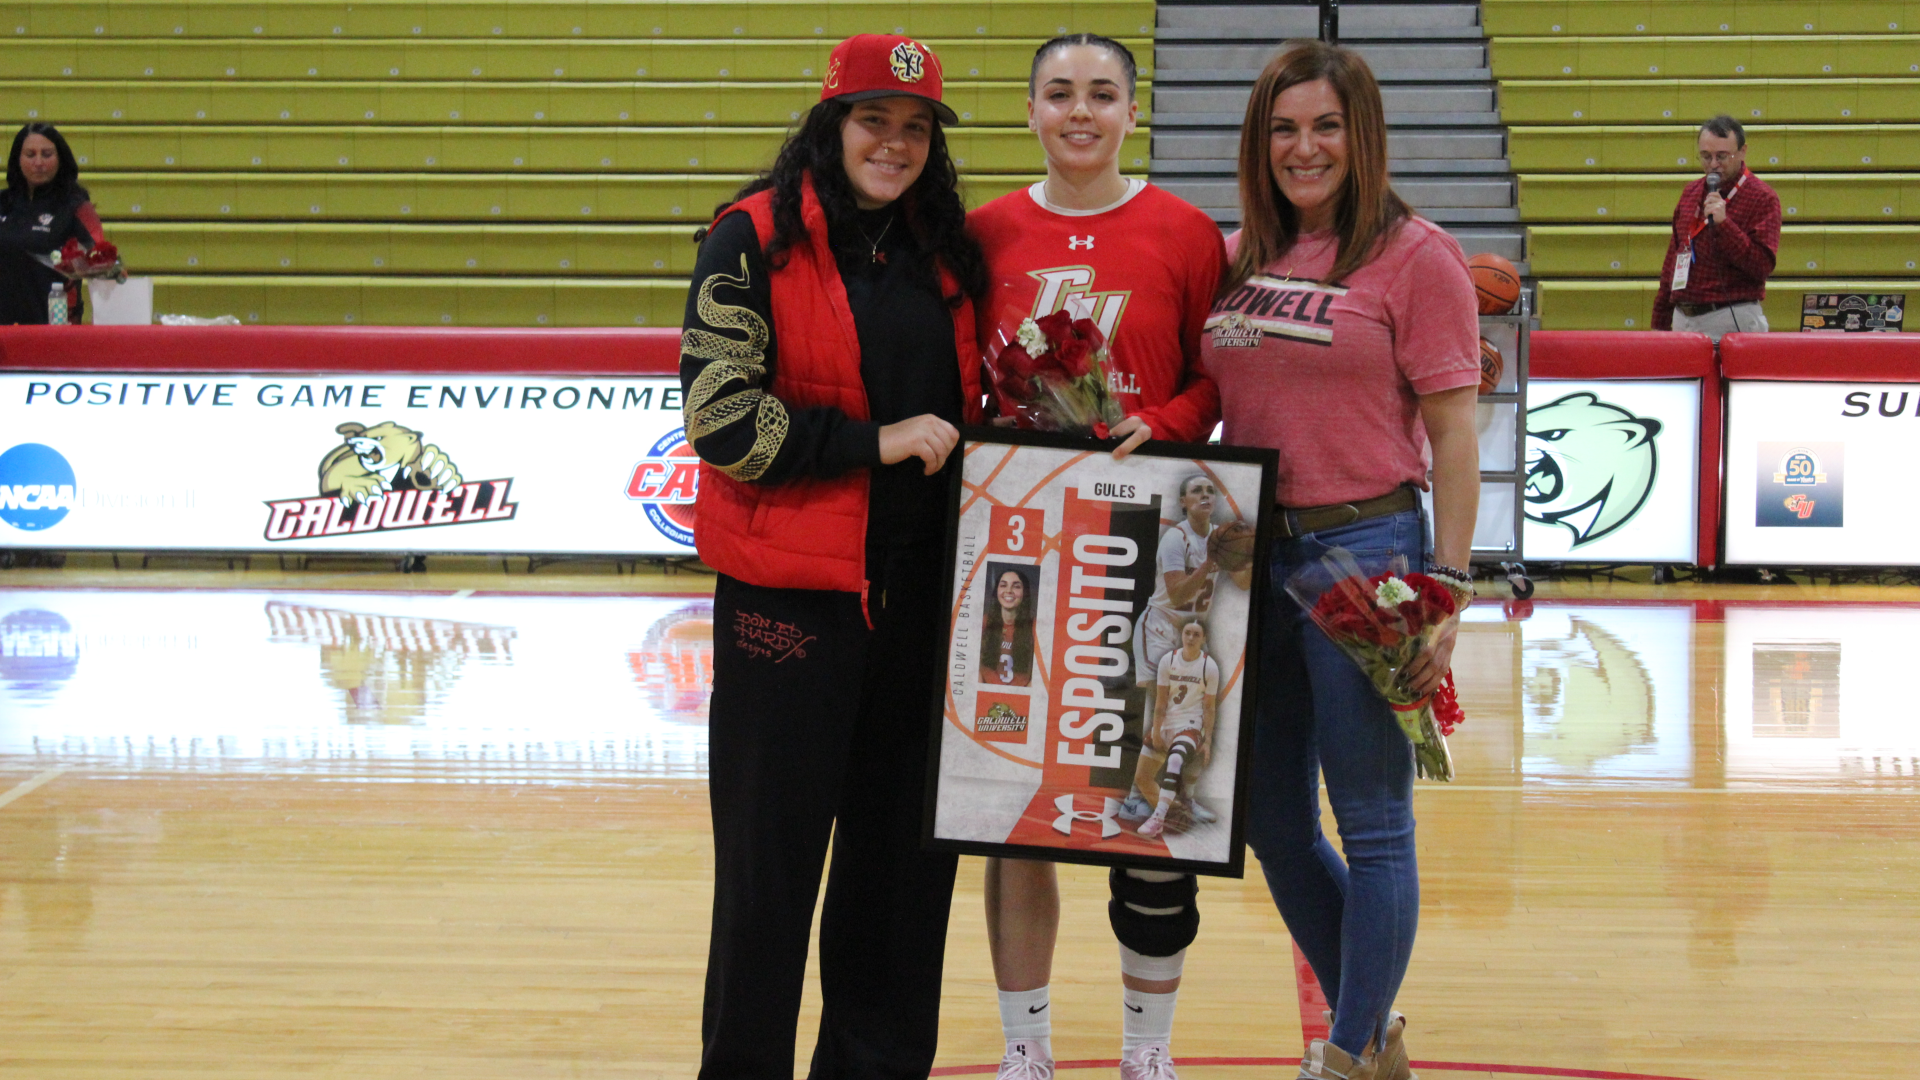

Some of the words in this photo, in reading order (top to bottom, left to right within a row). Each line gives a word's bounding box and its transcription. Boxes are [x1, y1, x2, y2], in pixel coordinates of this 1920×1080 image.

[1211, 285, 1334, 326] LDWELL
[25, 382, 238, 406] POSITIVE
[256, 384, 386, 407] GAME
[407, 385, 683, 410] ENVIRONME
[1107, 372, 1141, 394] ALL
[1841, 391, 1920, 417] SU
[1789, 460, 1812, 476] 50
[0, 484, 74, 510] NCAA
[1094, 482, 1136, 499] GULES
[267, 480, 514, 540] CALDWELL
[648, 508, 694, 544] COLLEGIATE
[1006, 515, 1026, 551] 3
[958, 535, 976, 618] BASKETBALL
[735, 609, 772, 628] DON
[953, 628, 969, 695] CALDWELL
[1056, 534, 1139, 769] ESPOSITO
[999, 654, 1014, 684] 3
[1173, 684, 1188, 705] 3
[976, 716, 1027, 725] CALDWELL
[977, 724, 1025, 732] UNIVERSITY
